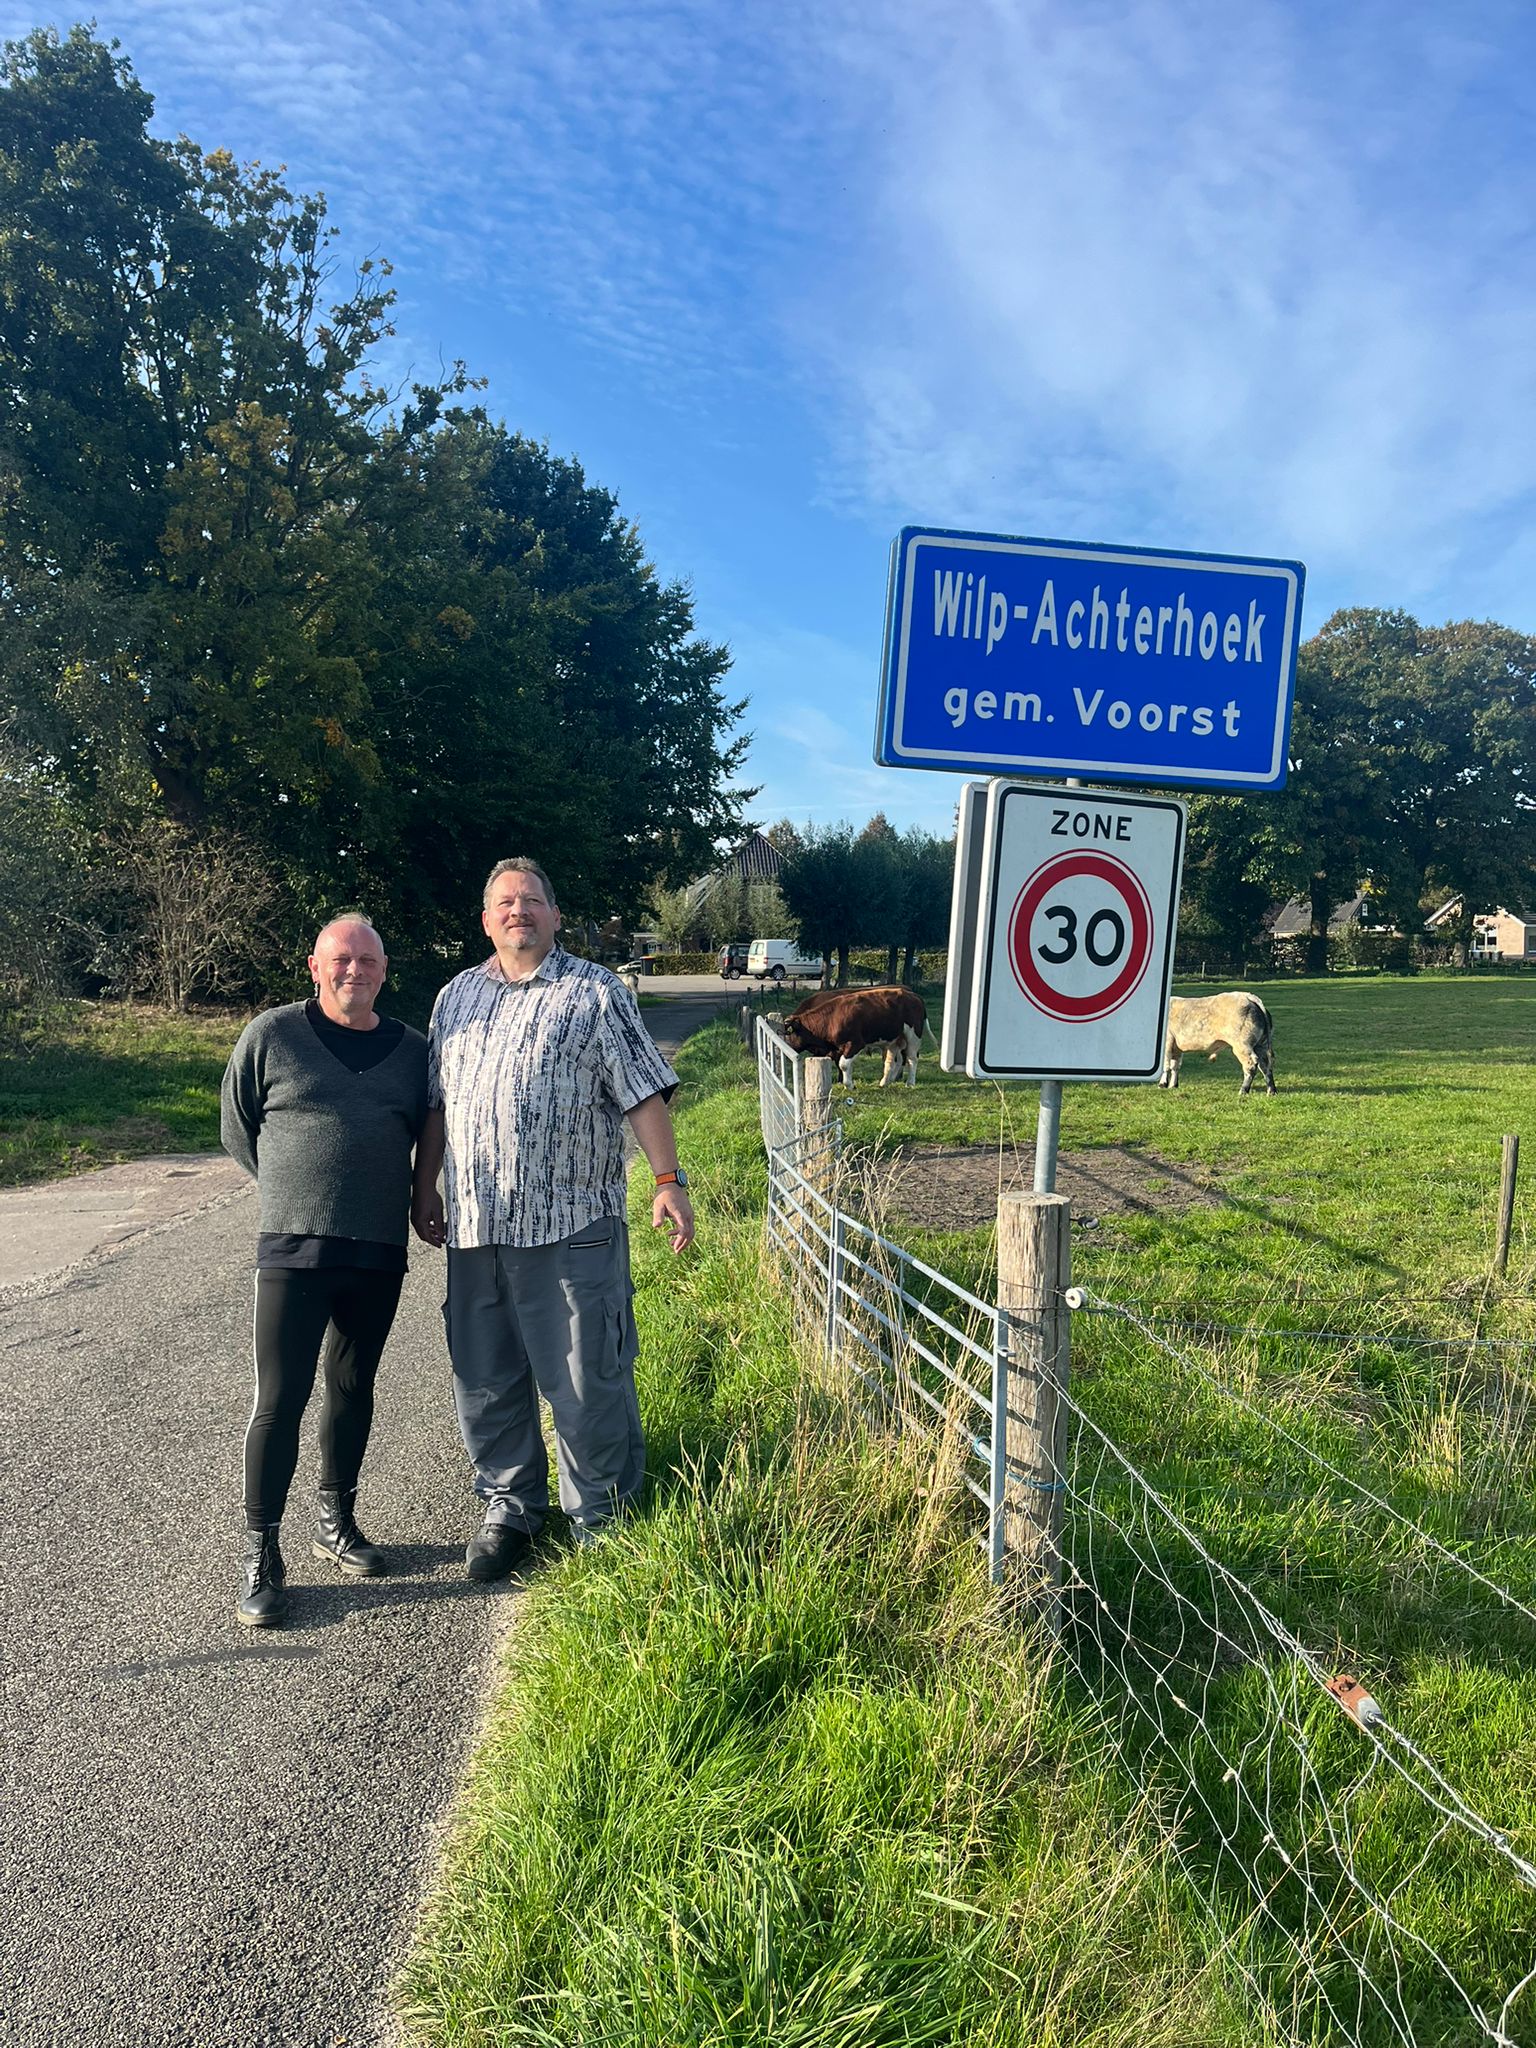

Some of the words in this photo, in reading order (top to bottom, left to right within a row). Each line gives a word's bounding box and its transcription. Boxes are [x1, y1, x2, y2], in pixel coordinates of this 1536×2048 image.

[934, 569, 1266, 663] Wilp-Achterhoek
[943, 686, 1055, 728] gem.
[1073, 687, 1241, 737] Voorst
[1051, 809, 1132, 842] ZONE
[1037, 905, 1125, 967] 30
